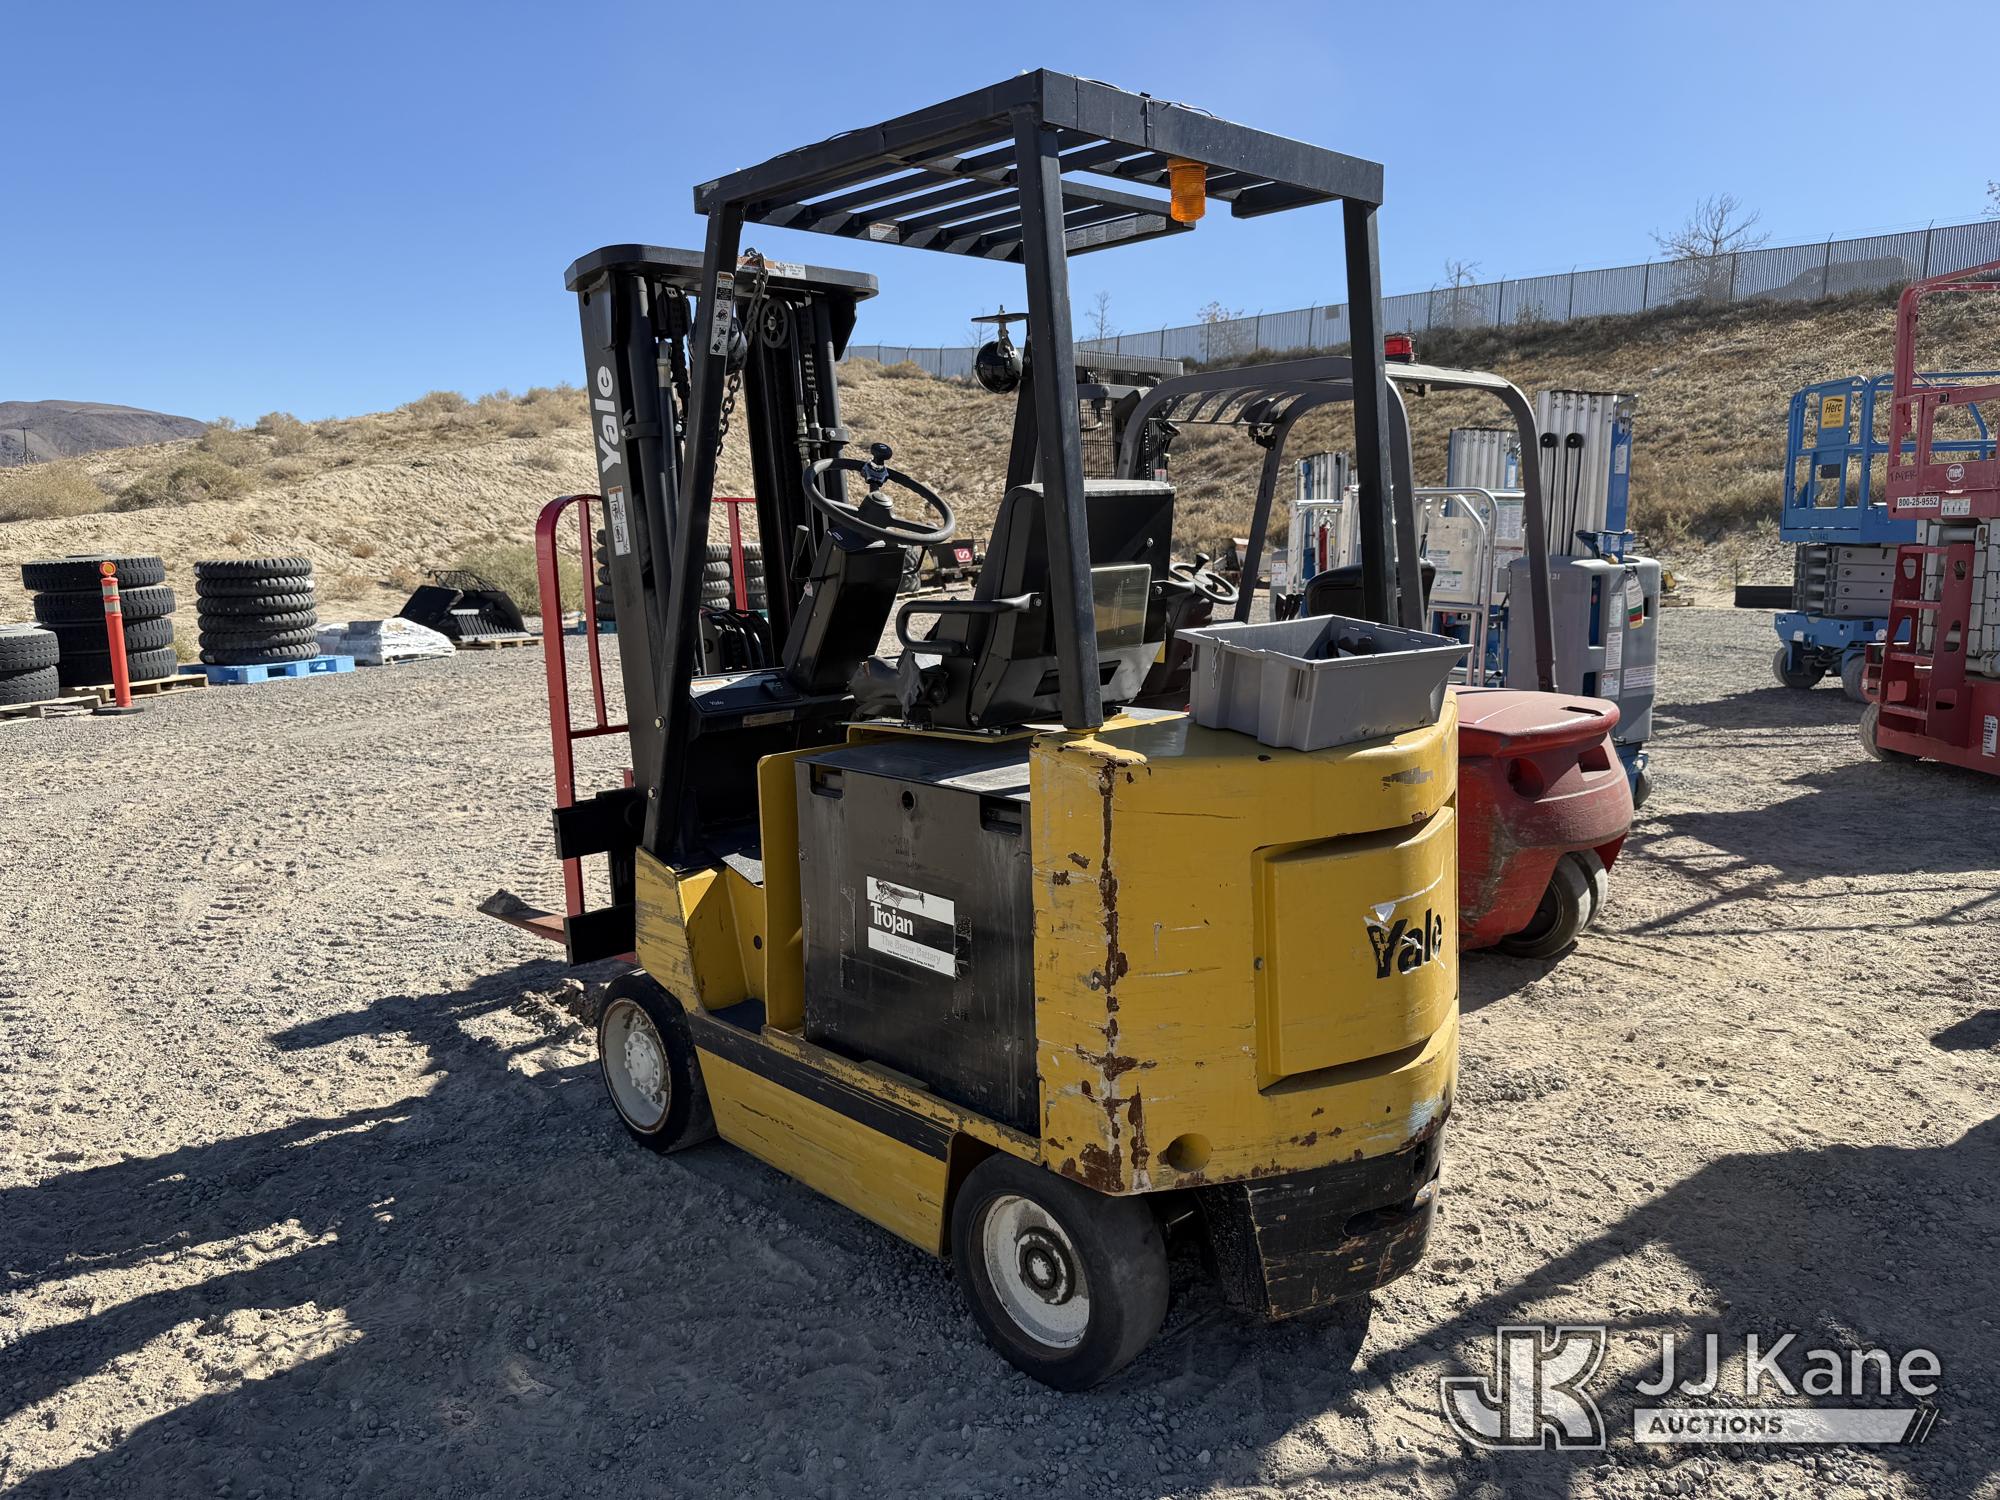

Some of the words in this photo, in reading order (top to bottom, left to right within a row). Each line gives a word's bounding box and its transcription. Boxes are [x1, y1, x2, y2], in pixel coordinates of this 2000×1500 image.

[595, 366, 621, 473] Yale
[1825, 403, 1842, 413] Herc
[870, 901, 914, 937] Trojan
[881, 935, 894, 947] The
[916, 944, 941, 966] Battery
[1366, 908, 1442, 979] Yale
